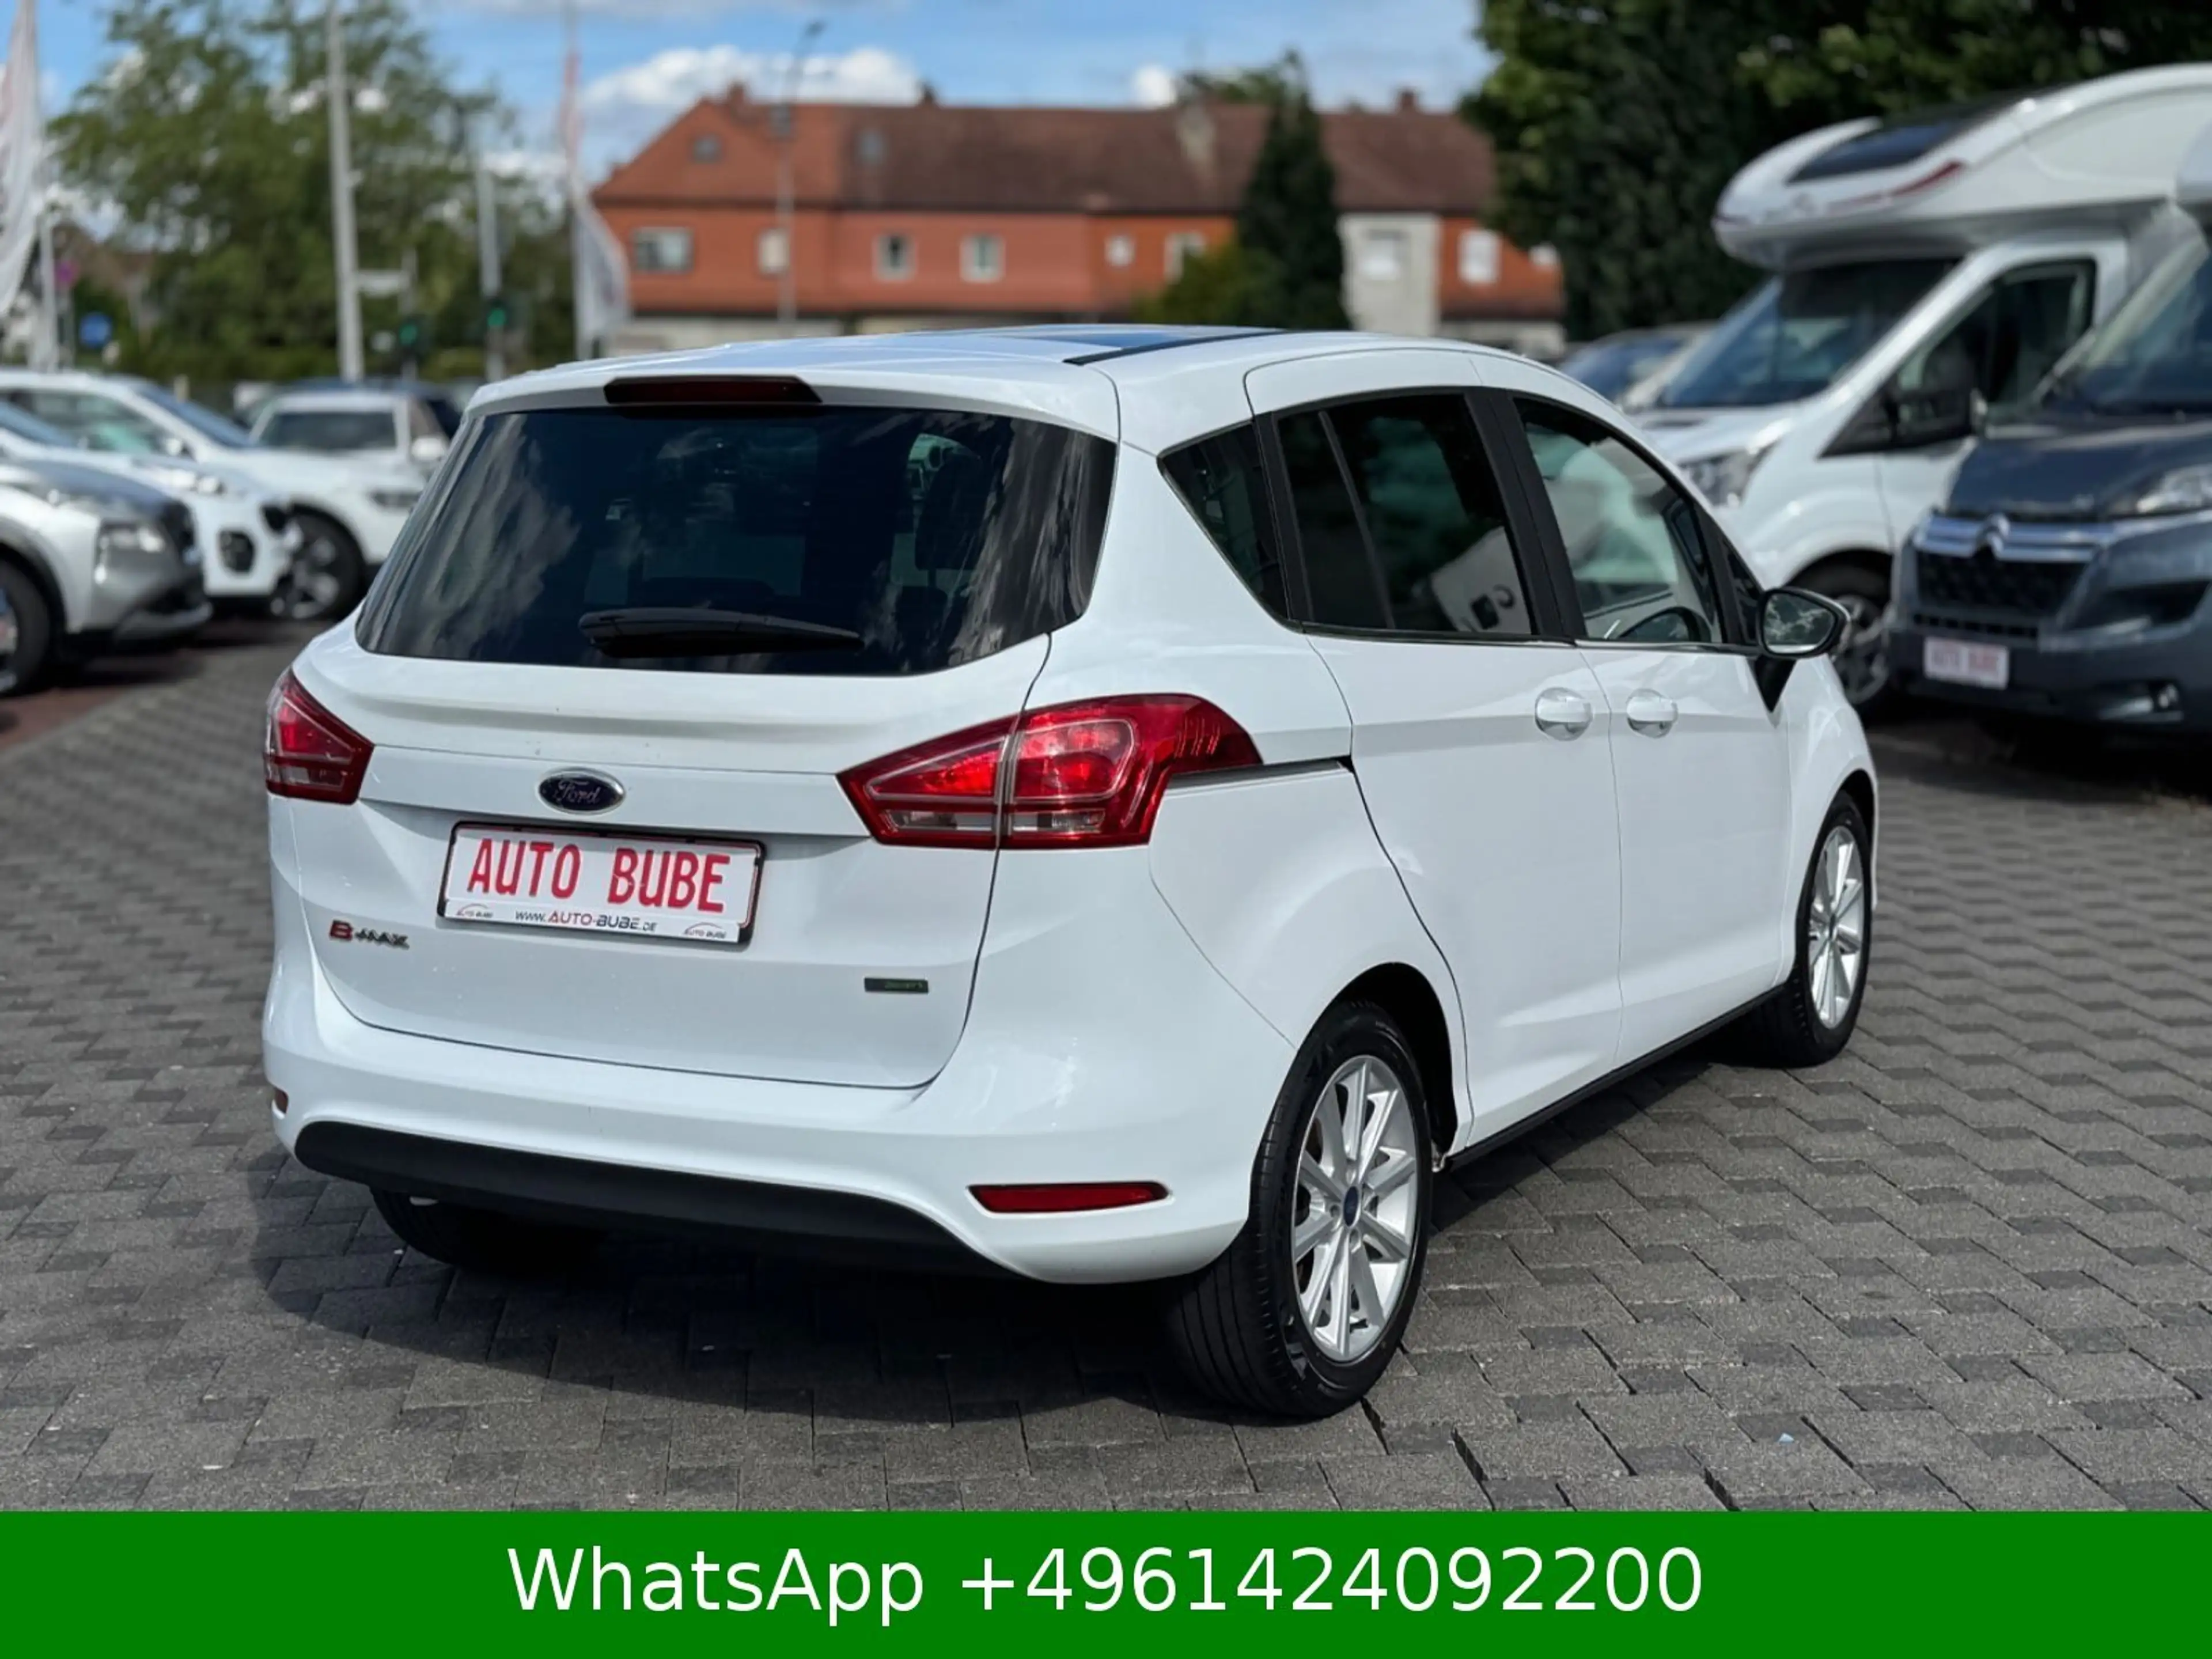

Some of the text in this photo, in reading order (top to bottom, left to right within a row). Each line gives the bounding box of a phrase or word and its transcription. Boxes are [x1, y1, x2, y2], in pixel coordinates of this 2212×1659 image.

[551, 778, 601, 804] Ford
[467, 838, 731, 913] AUTO BUBE
